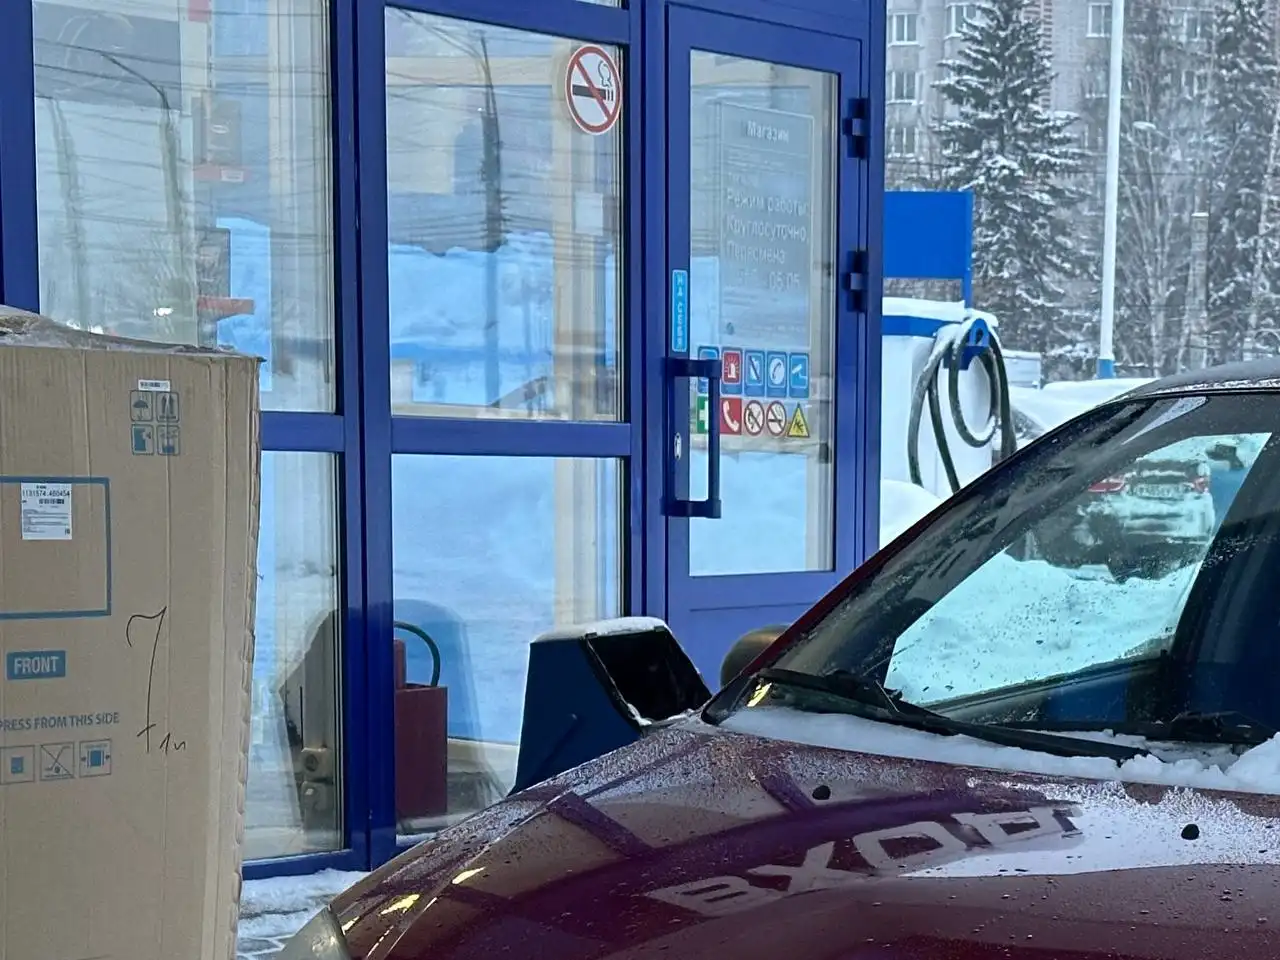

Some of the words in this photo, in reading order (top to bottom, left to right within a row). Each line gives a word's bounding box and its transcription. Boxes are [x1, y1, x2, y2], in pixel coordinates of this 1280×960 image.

[747, 120, 790, 142] Магазин
[14, 655, 60, 675] FRONT
[34, 715, 67, 729] FROM
[70, 713, 94, 727] THIS
[96, 711, 120, 725] SIDE
